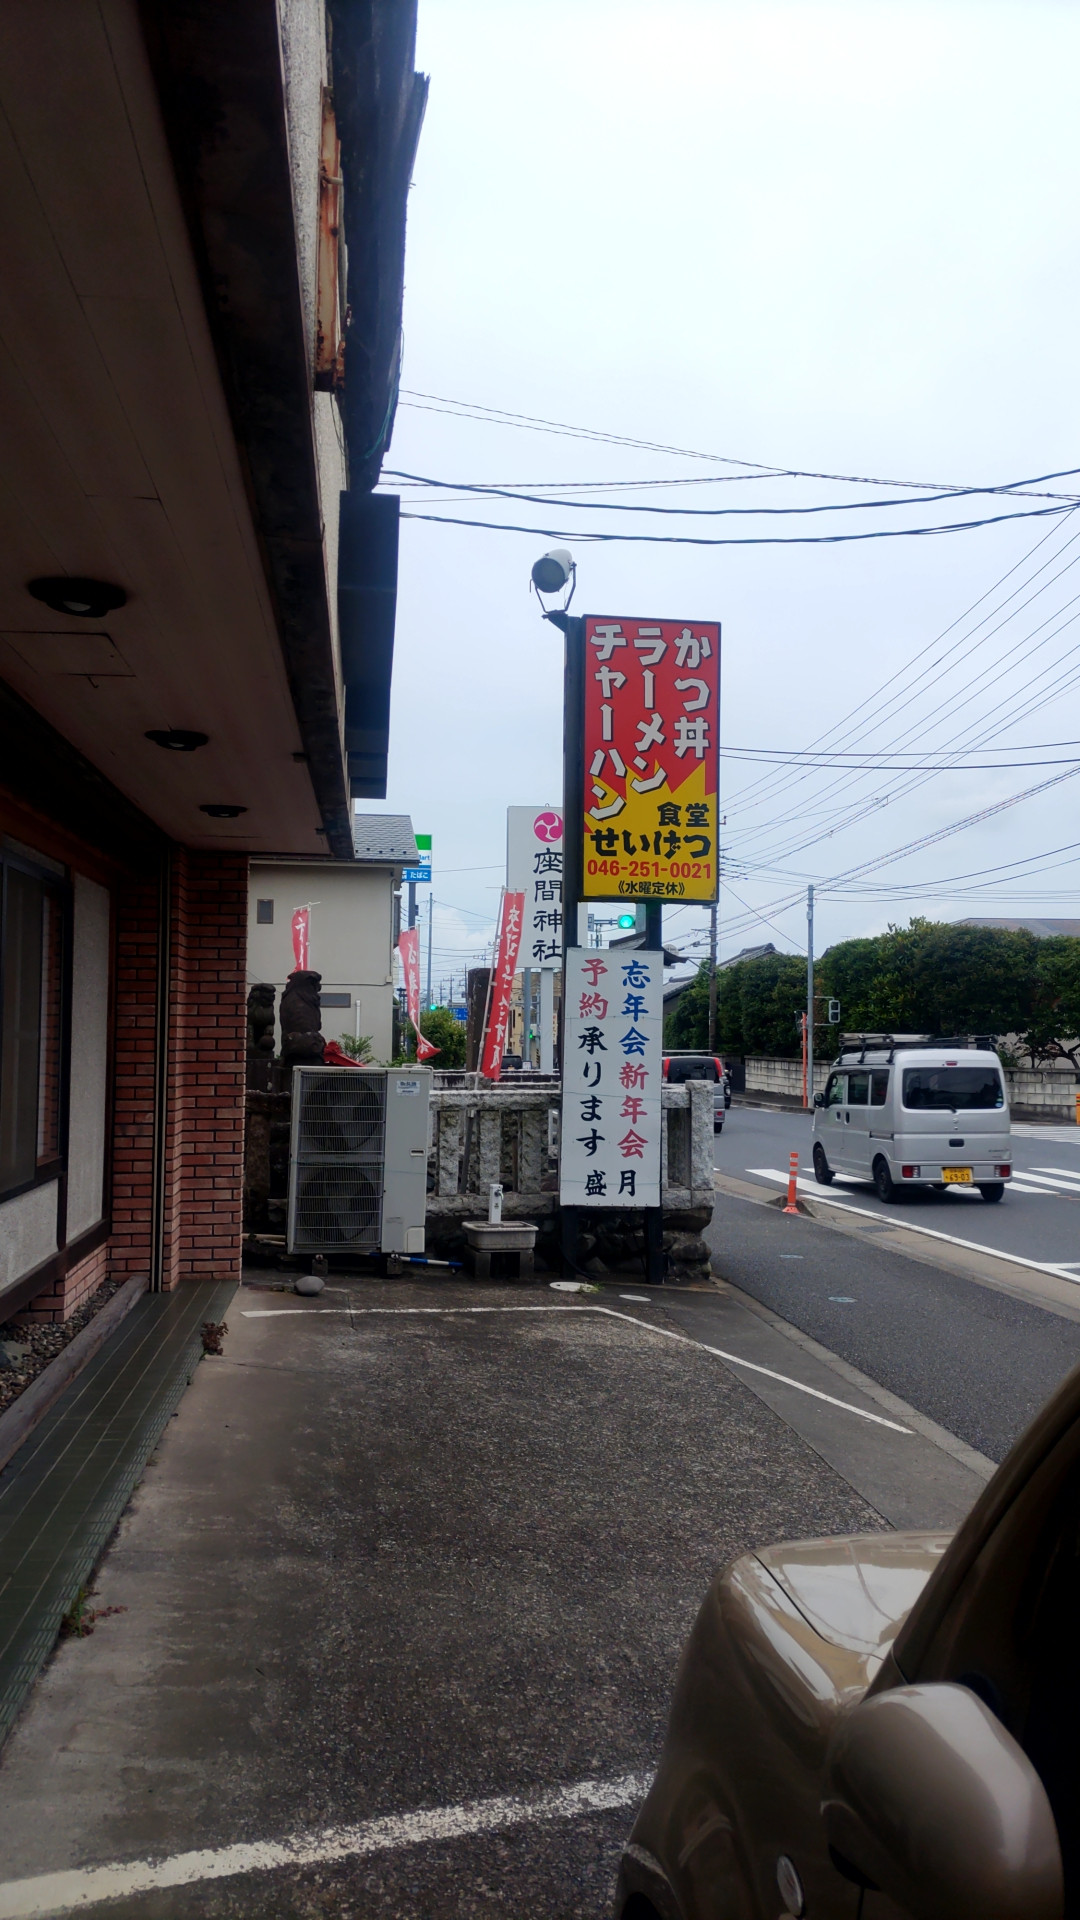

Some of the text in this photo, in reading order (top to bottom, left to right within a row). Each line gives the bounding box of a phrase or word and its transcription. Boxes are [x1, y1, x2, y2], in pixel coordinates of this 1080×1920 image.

[588, 624, 628, 821] チャーハン
[630, 627, 668, 795] ラーメン
[673, 627, 713, 759] かつ丼
[410, 871, 429, 879] たばこ
[587, 859, 711, 879] 046-251-0021
[590, 827, 712, 860] せいげつ
[657, 801, 710, 828] 食堂
[533, 847, 563, 962] 座間神社
[576, 958, 608, 1157] 予約承ります
[617, 959, 651, 1159] 忘年会新年会
